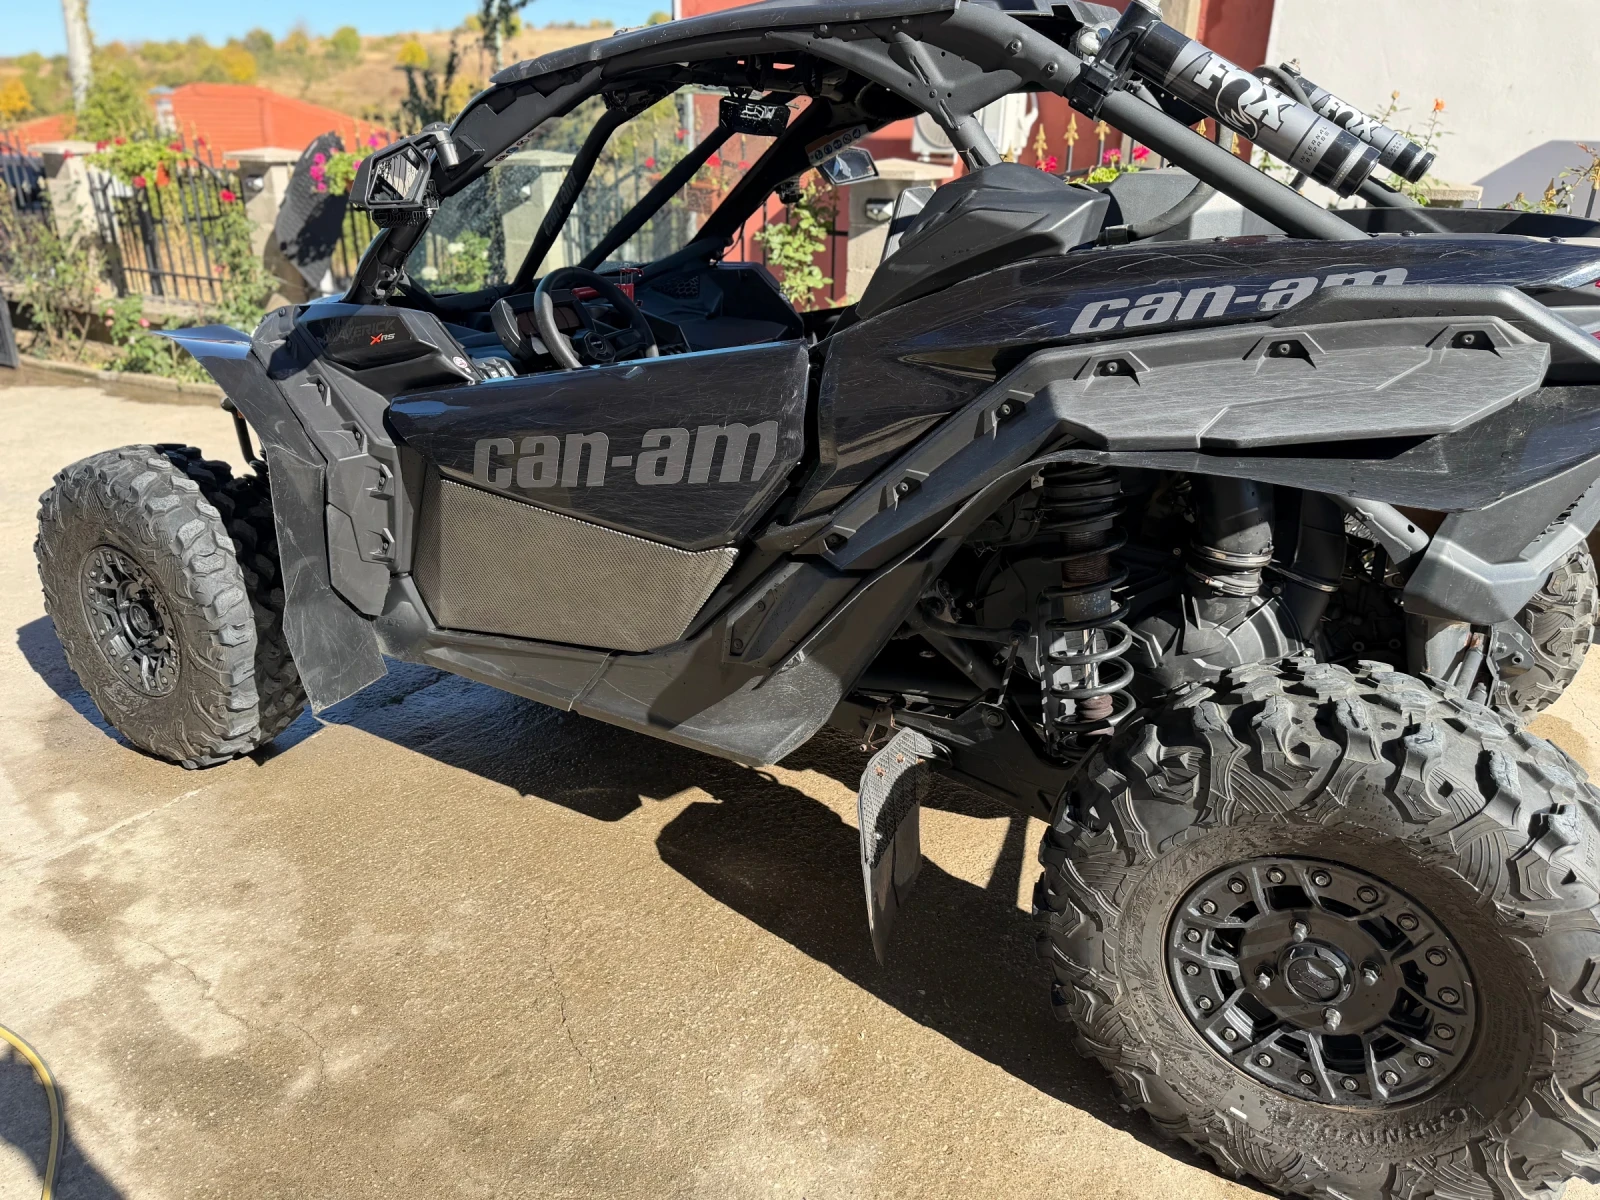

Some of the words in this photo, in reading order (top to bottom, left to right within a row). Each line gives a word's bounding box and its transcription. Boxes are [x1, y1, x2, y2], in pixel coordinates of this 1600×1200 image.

[1193, 51, 1298, 139] FOX
[1319, 93, 1382, 143] FOX
[1300, 126, 1328, 164] INTERNAL
[1306, 131, 1330, 164] BYPASS
[1070, 267, 1409, 334] can-am
[370, 332, 396, 345] XRS
[473, 420, 779, 489] can-am
